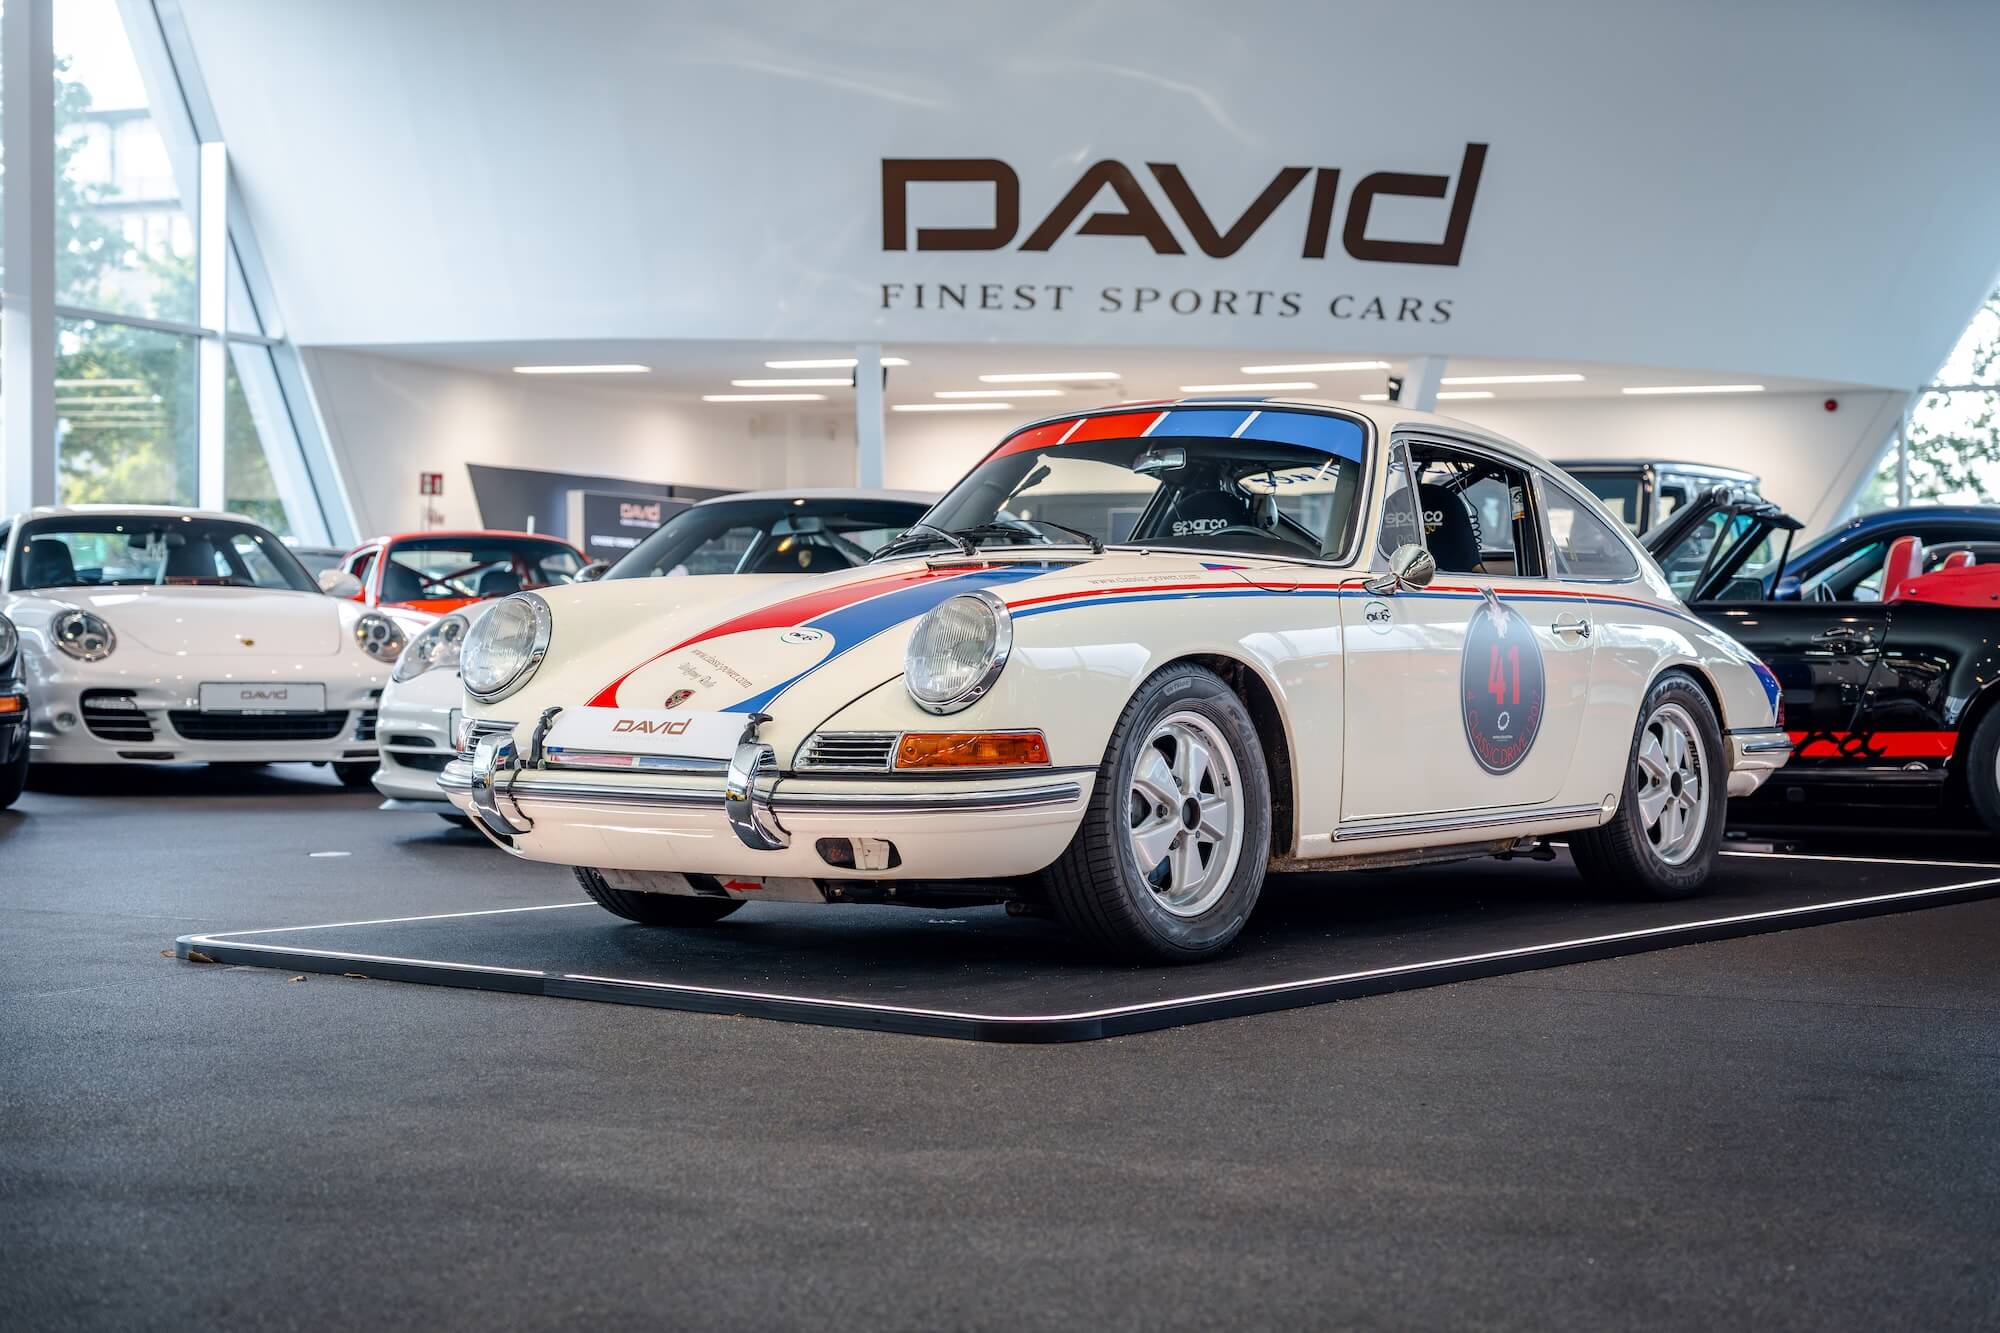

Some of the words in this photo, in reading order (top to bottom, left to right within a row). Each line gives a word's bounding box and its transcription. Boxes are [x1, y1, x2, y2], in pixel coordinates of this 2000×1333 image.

[881, 284, 1074, 312] FINEST
[1100, 286, 1302, 318] SPORTS
[1330, 294, 1454, 324] CARS
[1172, 518, 1228, 535] sparco
[1385, 510, 1443, 528] spaco
[1488, 643, 1520, 704] 41
[1469, 710, 1500, 765] CLASSIC
